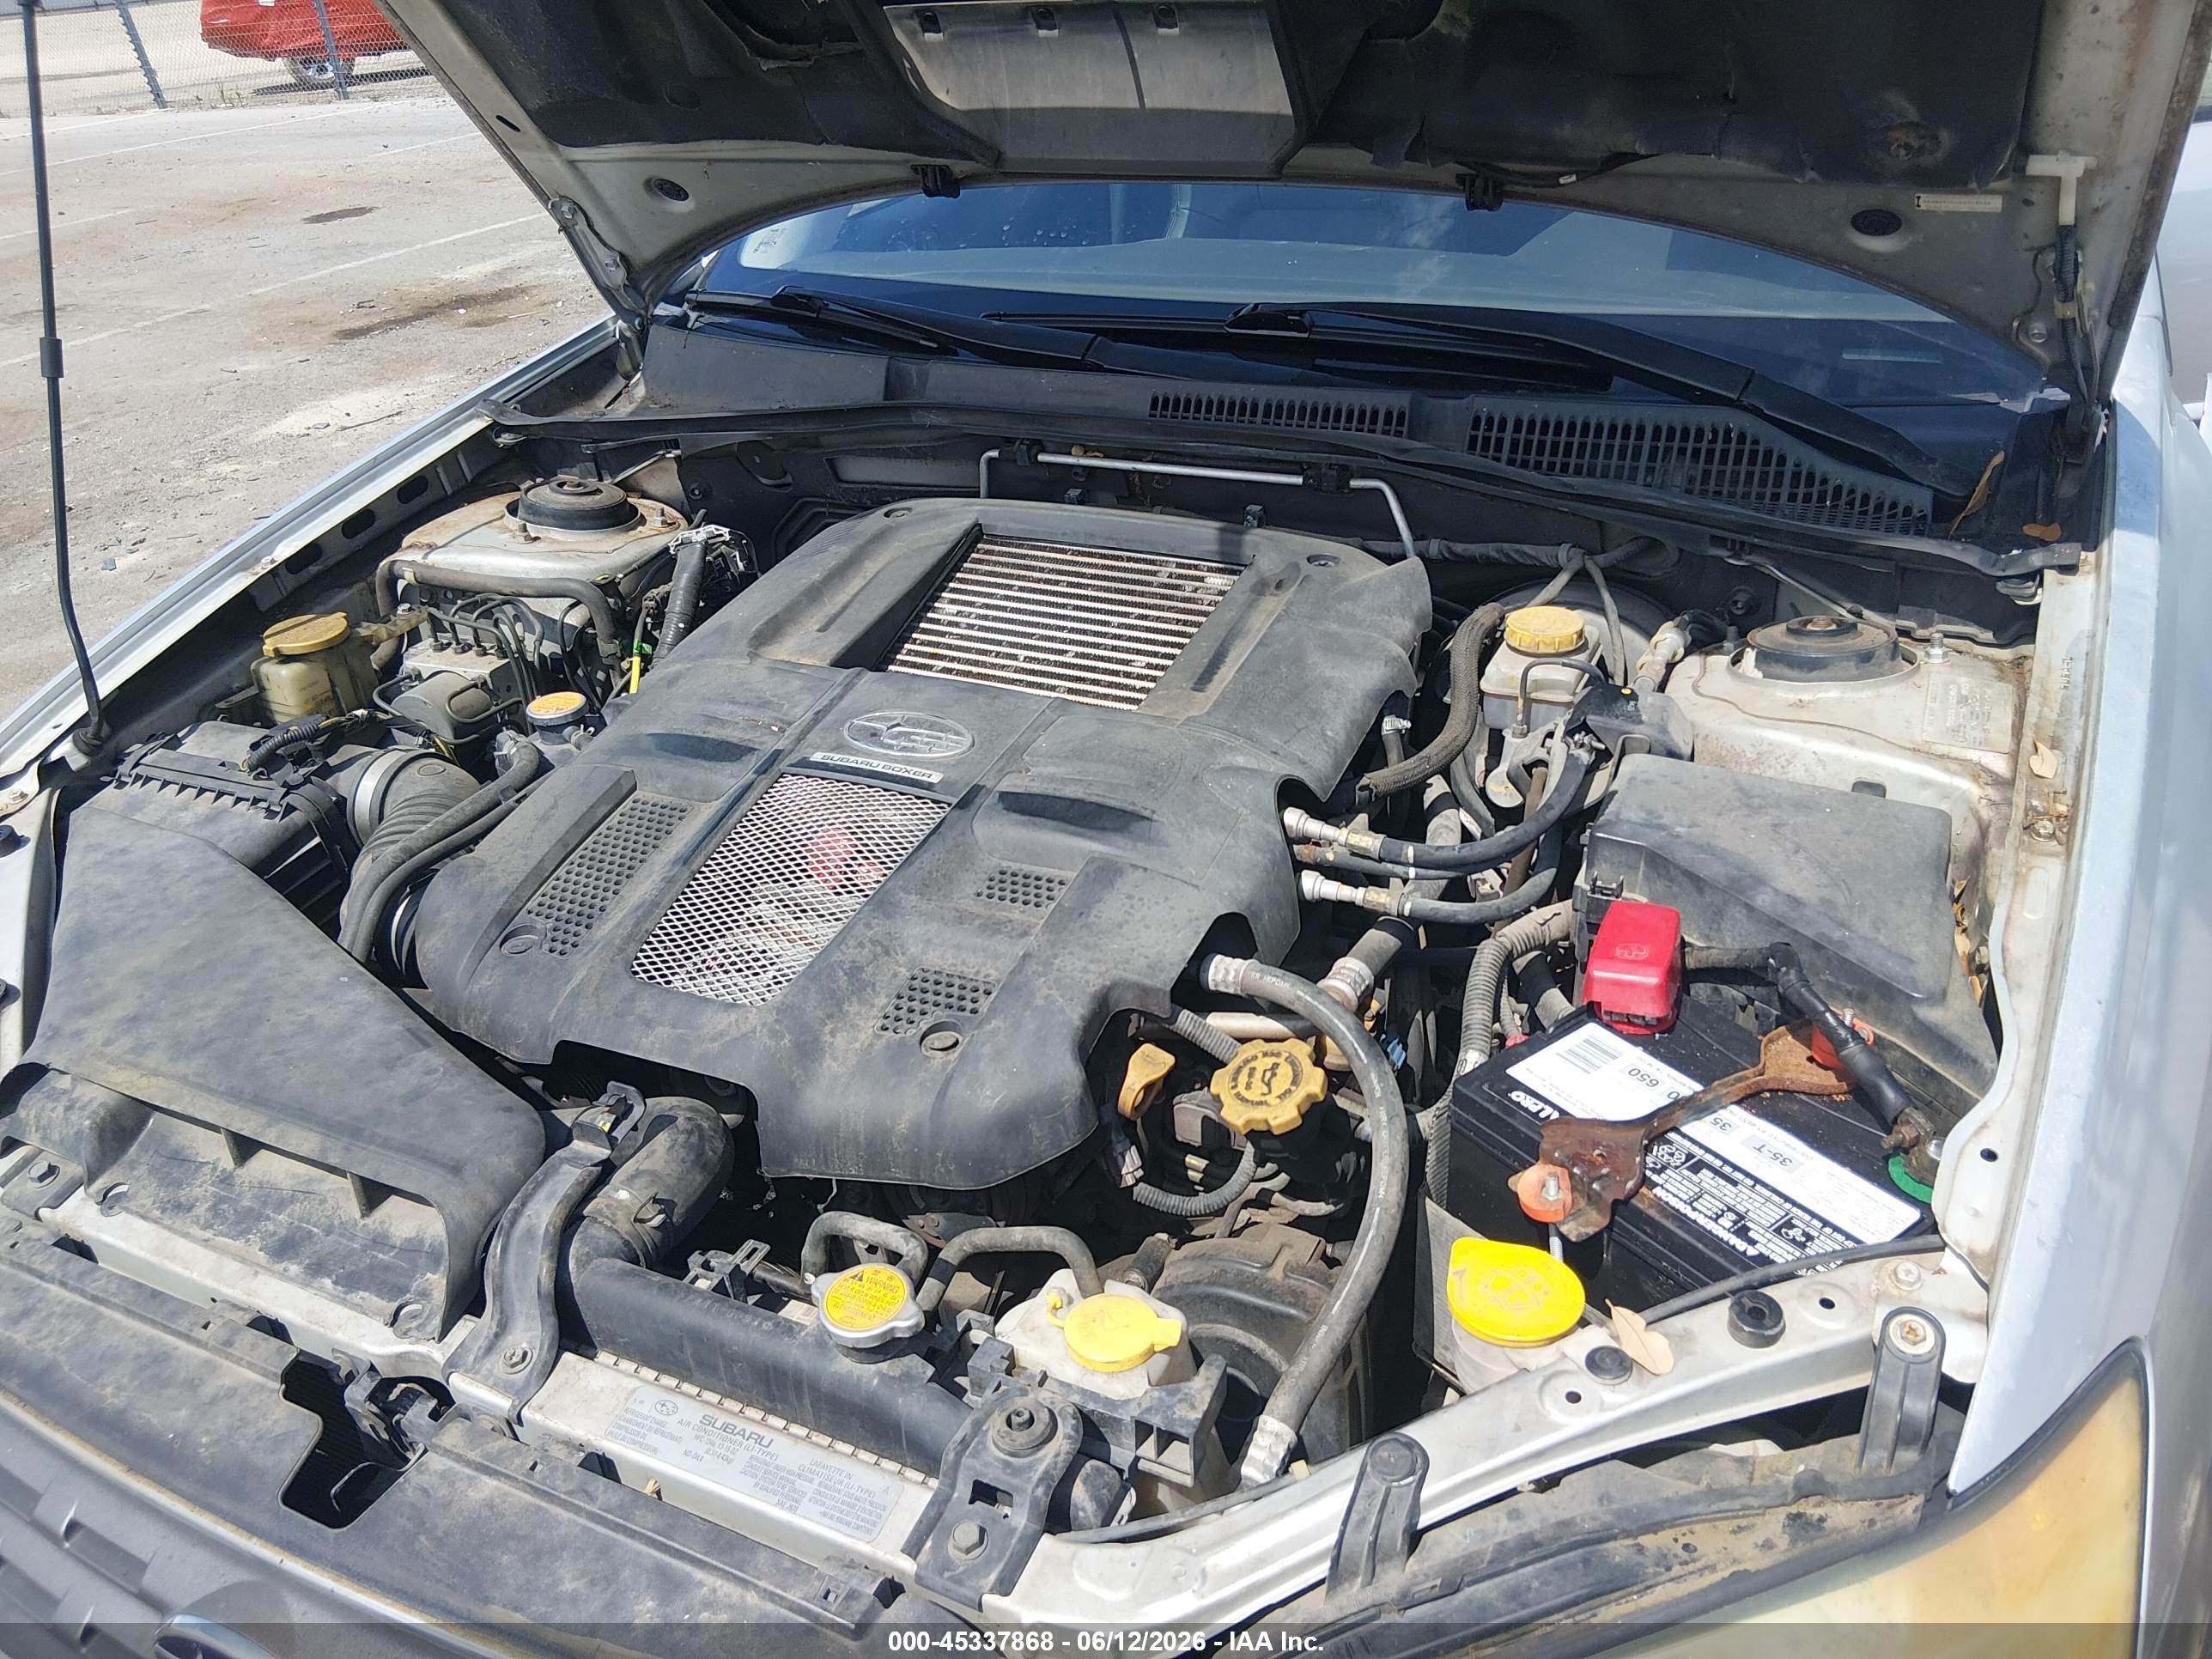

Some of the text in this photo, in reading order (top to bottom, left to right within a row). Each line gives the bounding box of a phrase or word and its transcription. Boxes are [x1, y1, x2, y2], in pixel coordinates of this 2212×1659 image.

[820, 755, 933, 779] SUBARU BOXER
[1626, 1066, 1659, 1088] 650
[1753, 1144, 1792, 1167] 35-T
[677, 1419, 690, 1428] AIR
[691, 1423, 744, 1448] CONDITIONER
[698, 1413, 774, 1449] SUBARU
